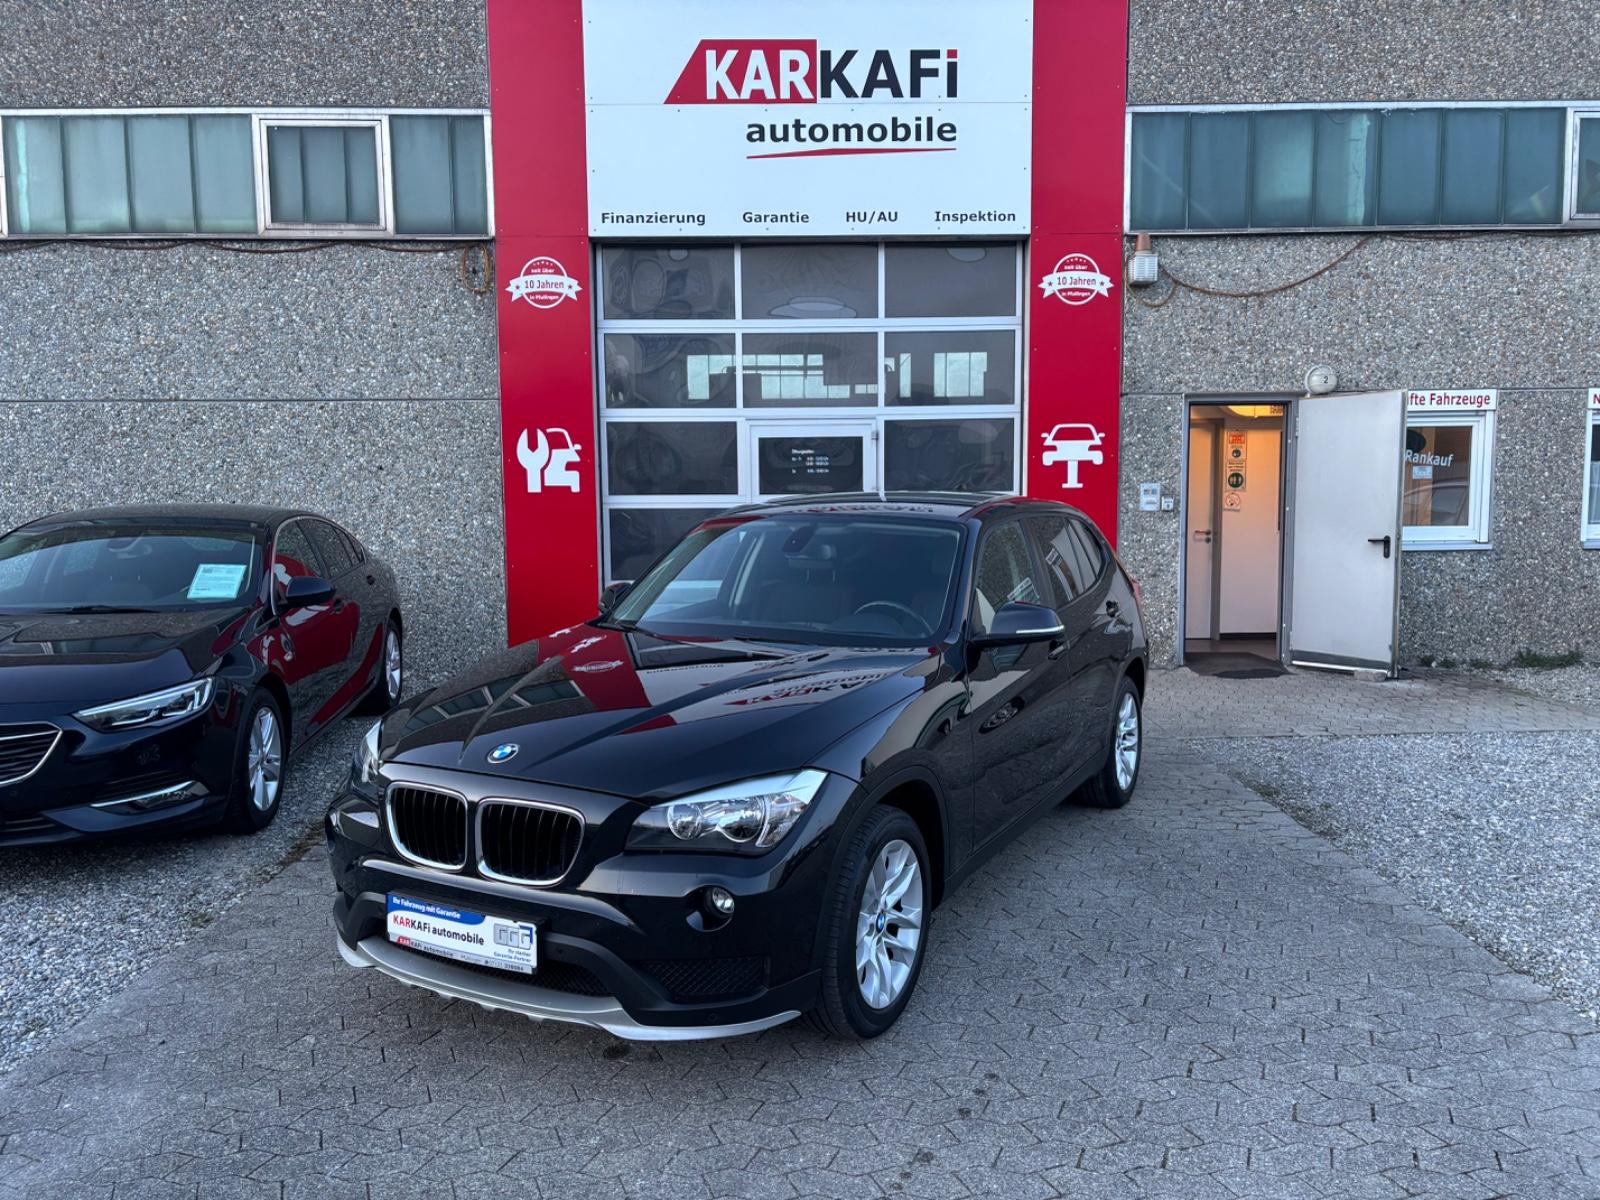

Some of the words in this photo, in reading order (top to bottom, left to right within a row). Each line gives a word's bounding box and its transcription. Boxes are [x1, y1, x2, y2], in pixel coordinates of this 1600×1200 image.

[705, 49, 958, 100] KARKAFi
[746, 117, 957, 143] automobile
[601, 211, 706, 227] Finanzierung
[742, 211, 810, 224] Garantie
[845, 211, 898, 224] HU/AU
[934, 210, 1017, 226] Inspektion
[524, 280, 534, 289] 10
[536, 279, 564, 289] Jahren
[1057, 277, 1067, 286] 10
[1069, 276, 1096, 286] Jahren
[1323, 376, 1329, 384] 2
[1430, 392, 1491, 408] Fahrzeuge
[401, 898, 425, 912] Fahrzeug
[425, 905, 436, 914] mit
[436, 907, 461, 919] Garantie
[393, 914, 431, 934] KARKAFi
[432, 925, 485, 946] automobile
